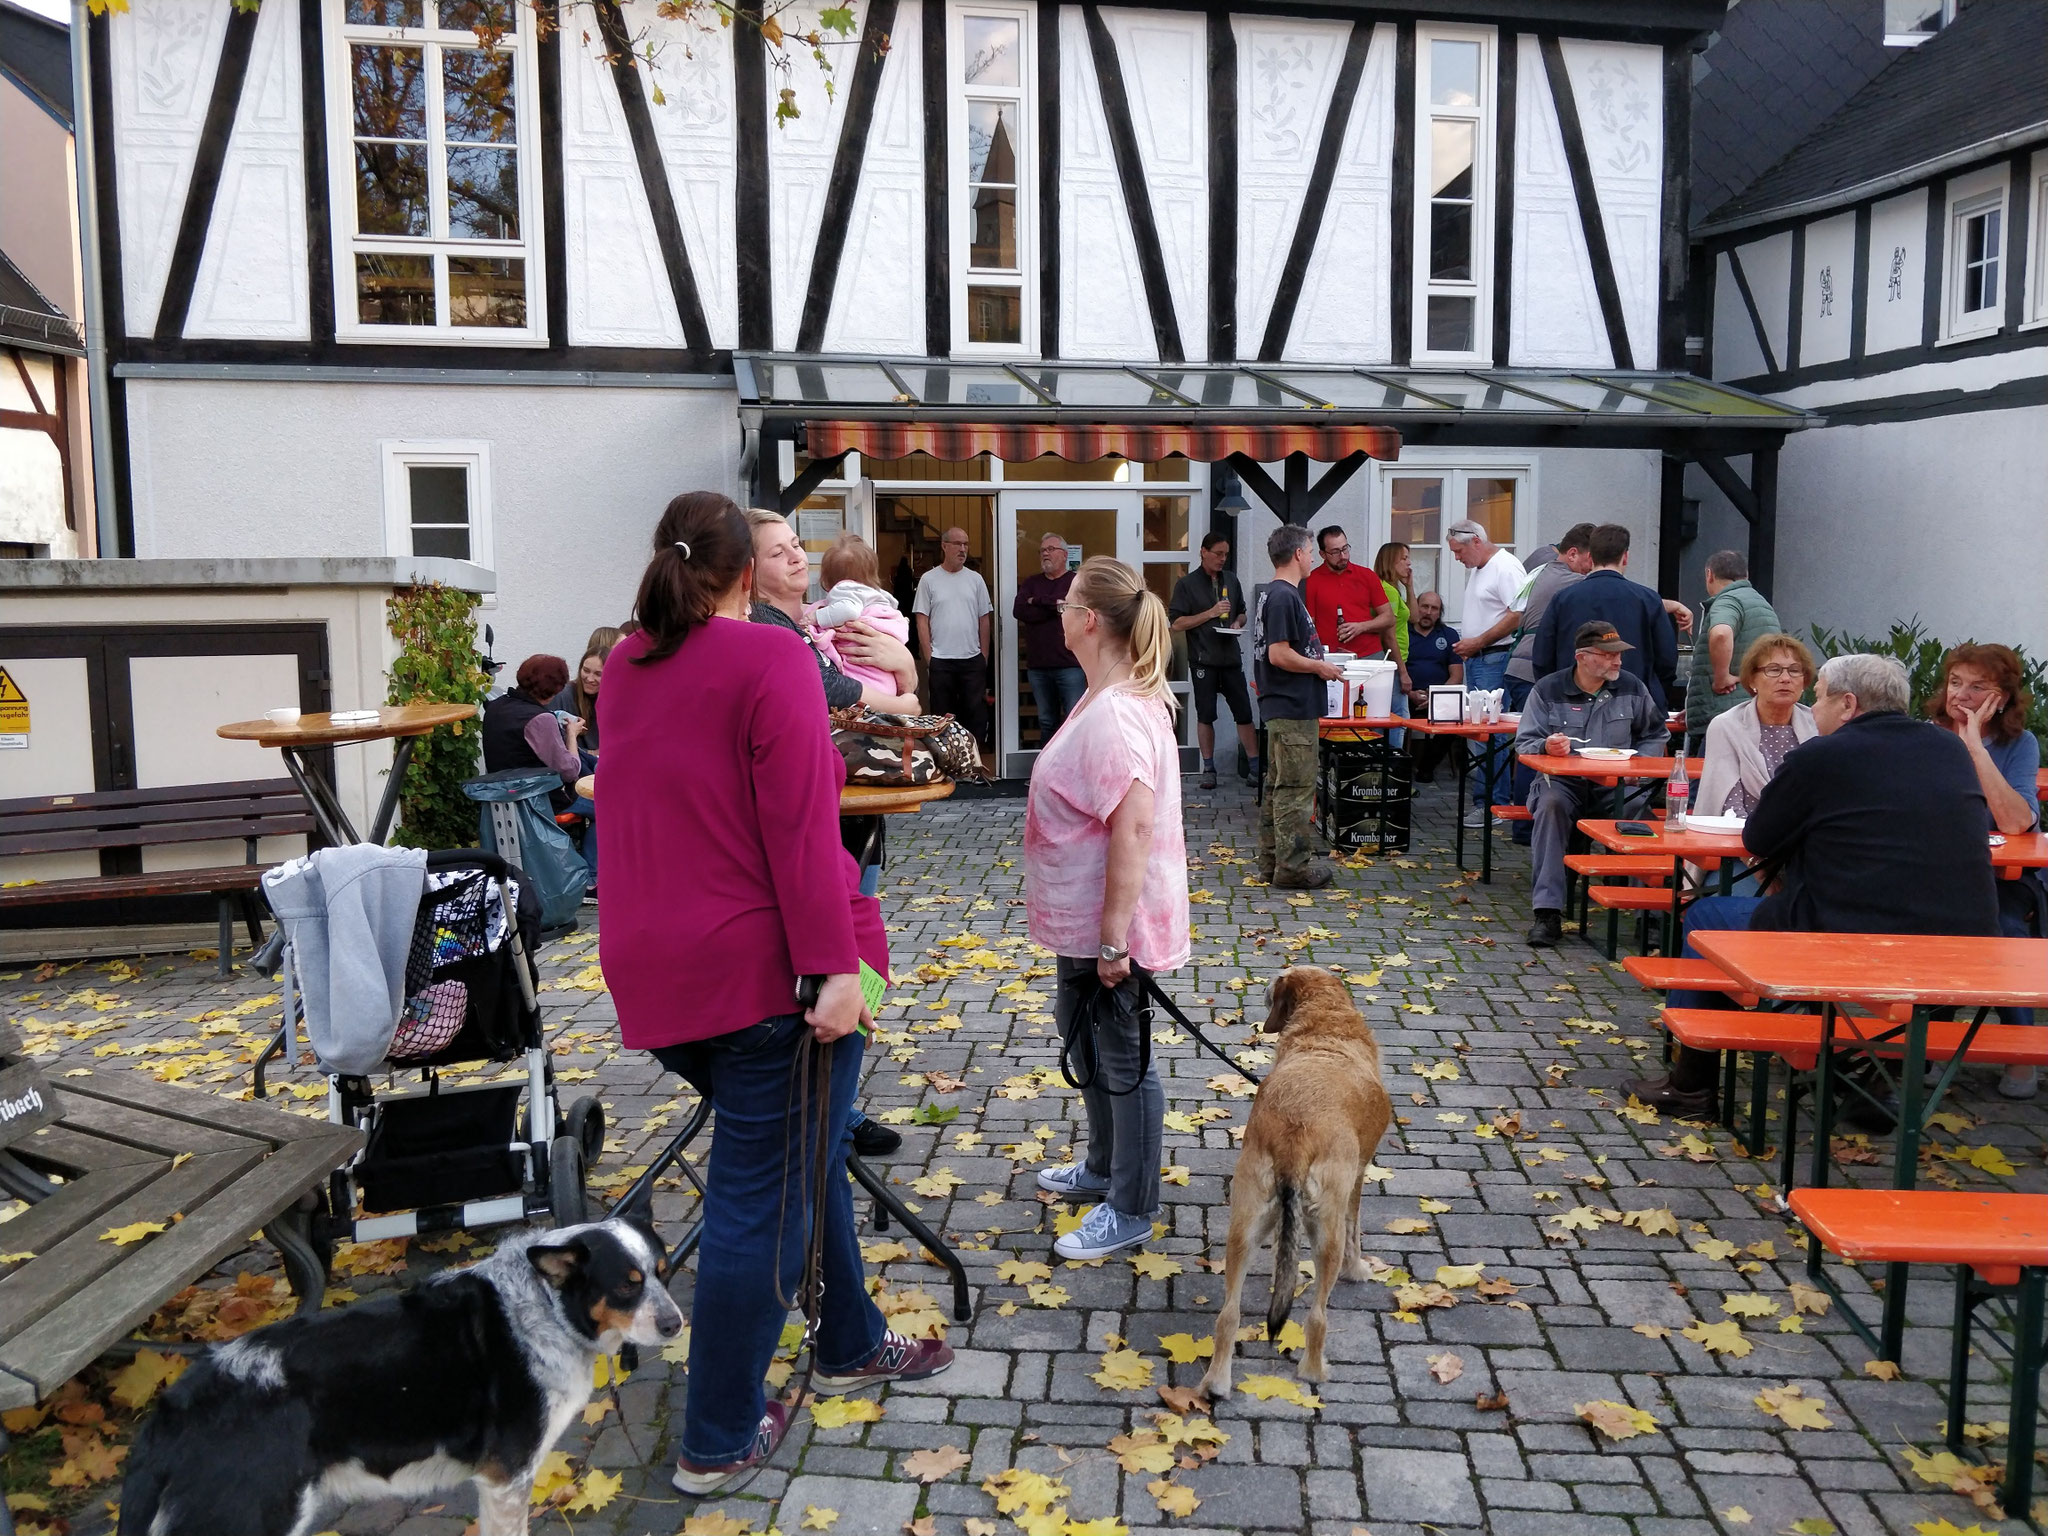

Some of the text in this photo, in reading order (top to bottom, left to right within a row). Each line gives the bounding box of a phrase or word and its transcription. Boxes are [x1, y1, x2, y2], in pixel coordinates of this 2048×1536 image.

[1351, 832, 1397, 843] Krombaher
[0, 1086, 43, 1123] ibach
[876, 1345, 906, 1369] N
[754, 1430, 771, 1458] N
